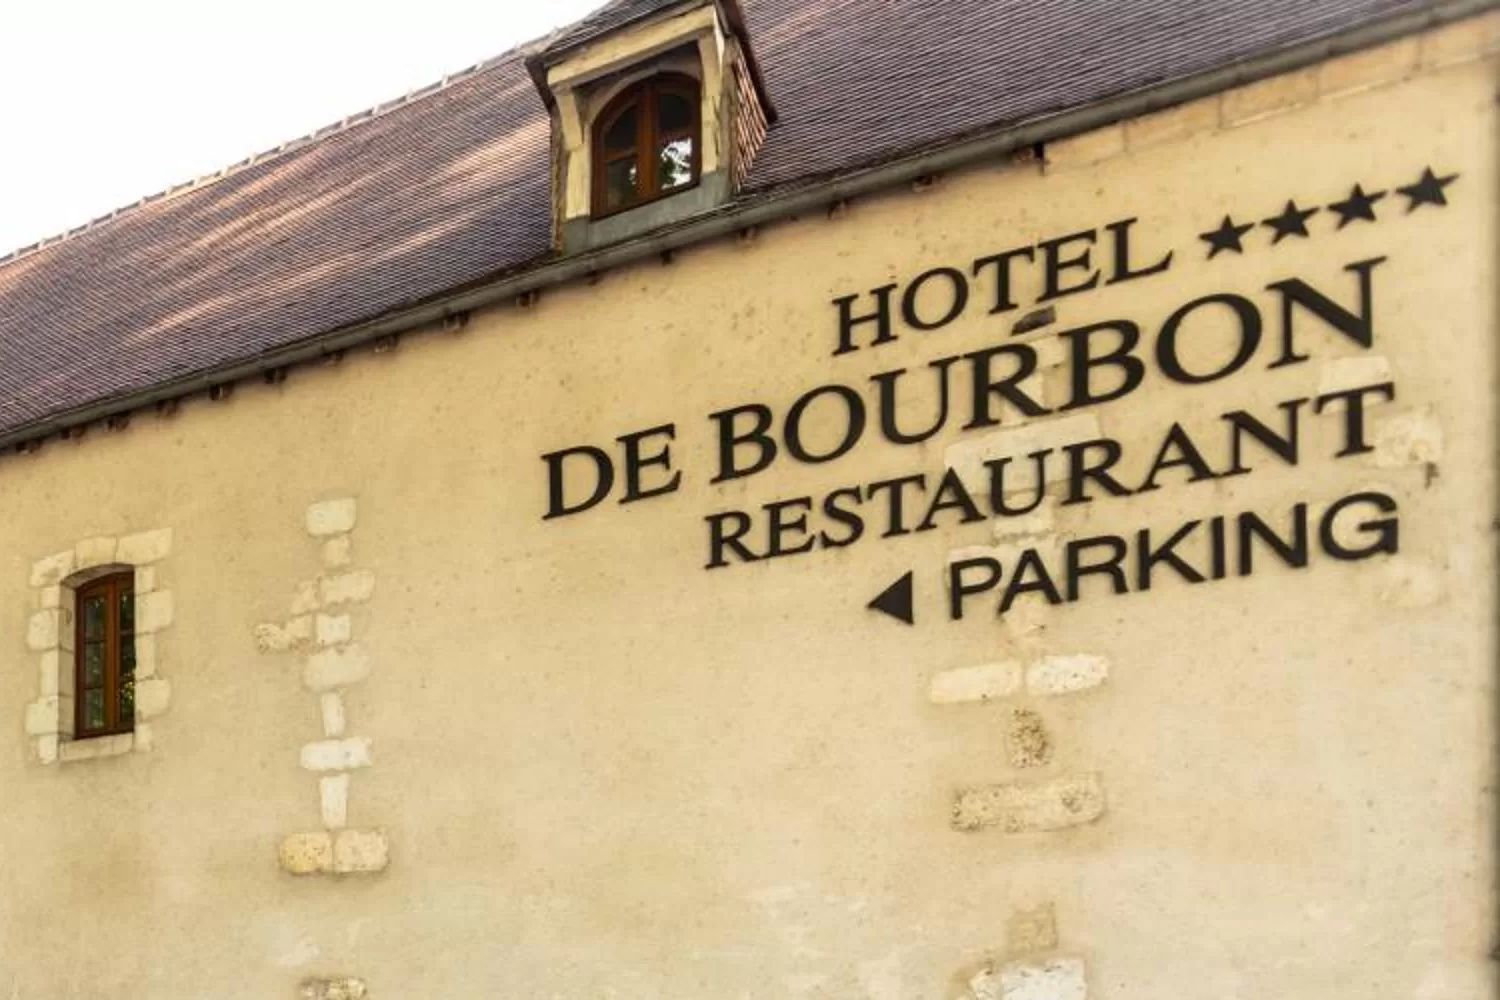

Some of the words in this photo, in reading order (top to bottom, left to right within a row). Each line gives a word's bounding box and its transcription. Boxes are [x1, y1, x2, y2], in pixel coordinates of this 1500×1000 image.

[831, 216, 1173, 357] HOTEL
[540, 422, 682, 521] DE
[707, 255, 1388, 485] BOURBON
[703, 381, 1395, 571] RESTAURANT
[948, 491, 1399, 621] PARKING
